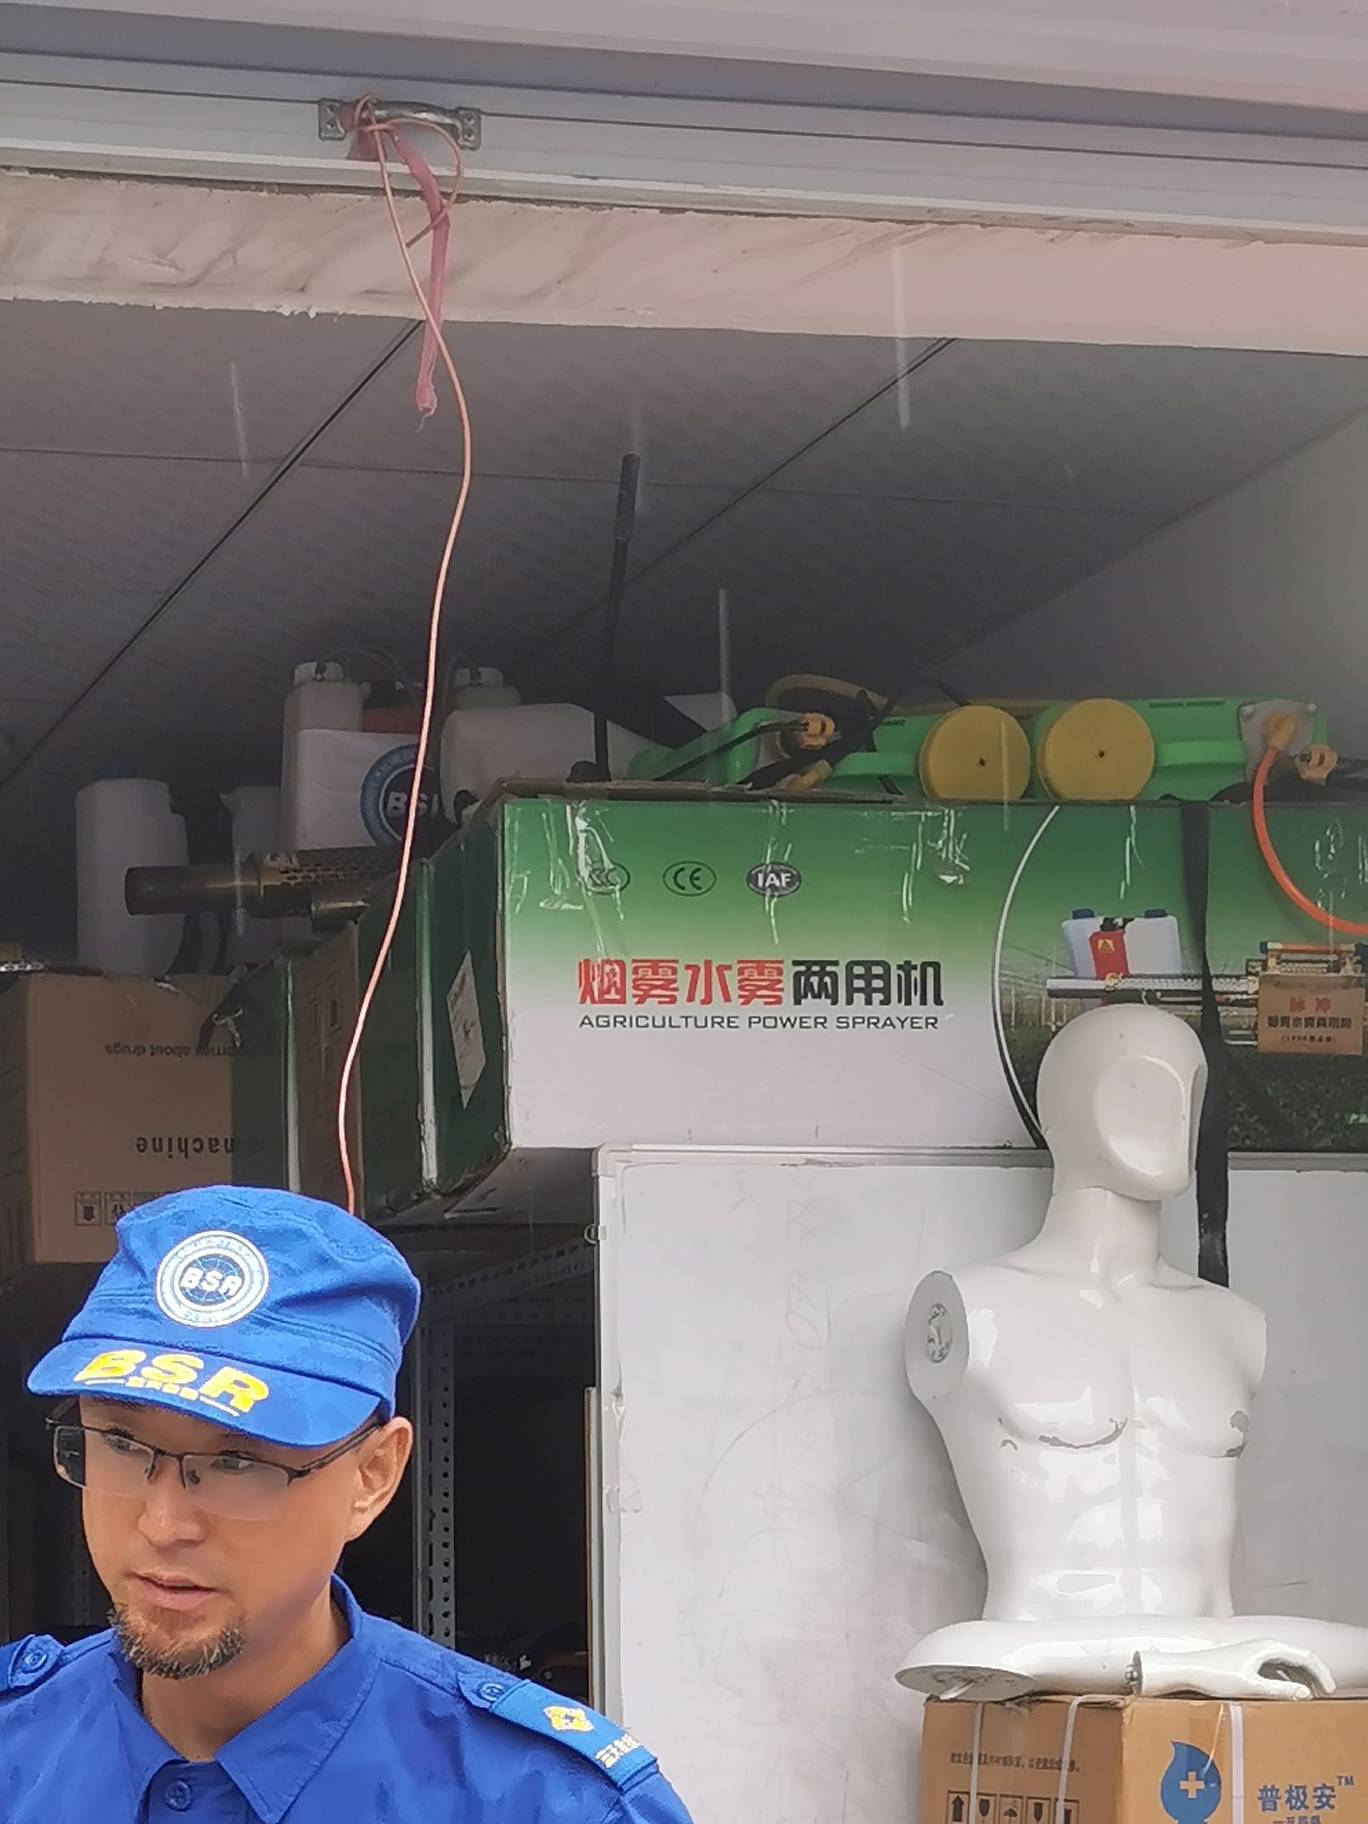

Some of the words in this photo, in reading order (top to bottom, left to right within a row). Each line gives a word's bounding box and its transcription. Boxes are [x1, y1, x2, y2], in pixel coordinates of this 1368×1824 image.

[756, 871, 793, 889] IAF
[578, 958, 944, 1006] 烟雾水雾两用机
[578, 1014, 740, 1030] AGRICULTURE
[747, 1014, 828, 1030] POWER
[835, 1015, 939, 1031] SPRAYER
[180, 1266, 244, 1297] BSR
[73, 1349, 270, 1413] BSR
